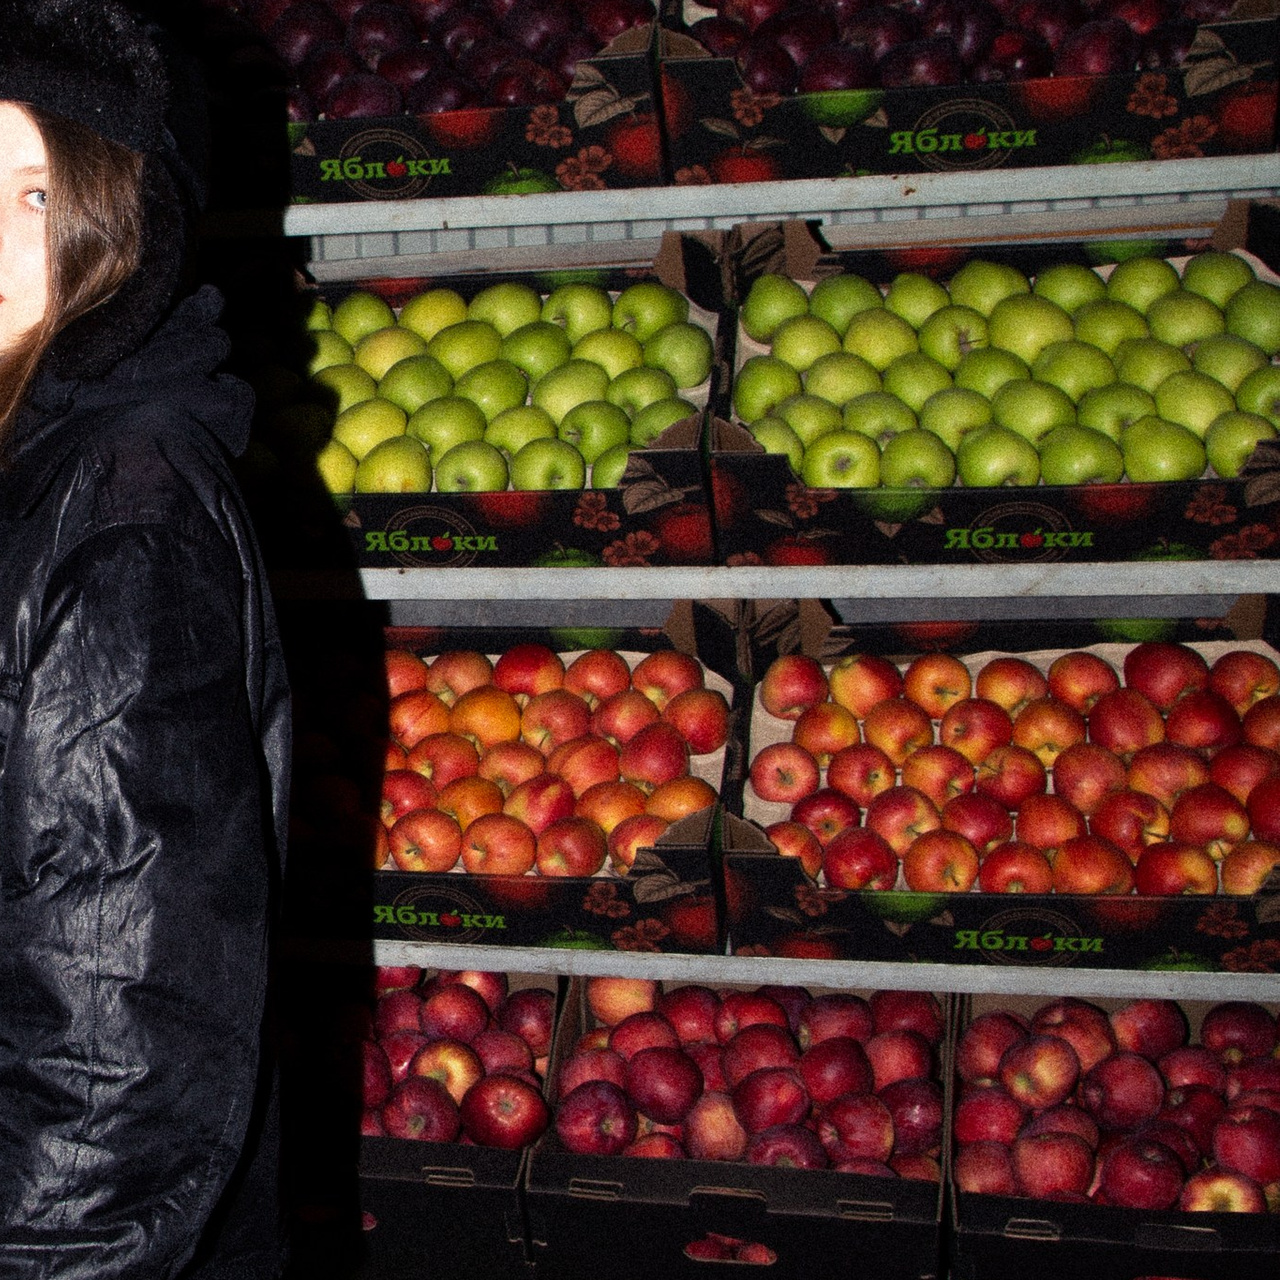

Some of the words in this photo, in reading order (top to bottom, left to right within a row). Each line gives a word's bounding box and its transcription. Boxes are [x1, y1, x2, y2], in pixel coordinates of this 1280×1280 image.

[888, 129, 1034, 155] Яблоки
[319, 157, 450, 182] Яблоки
[364, 531, 498, 552] Яблоки
[944, 528, 1091, 549] Яблоки
[373, 904, 505, 928] Яблоки
[954, 929, 1101, 952] Яблоки
